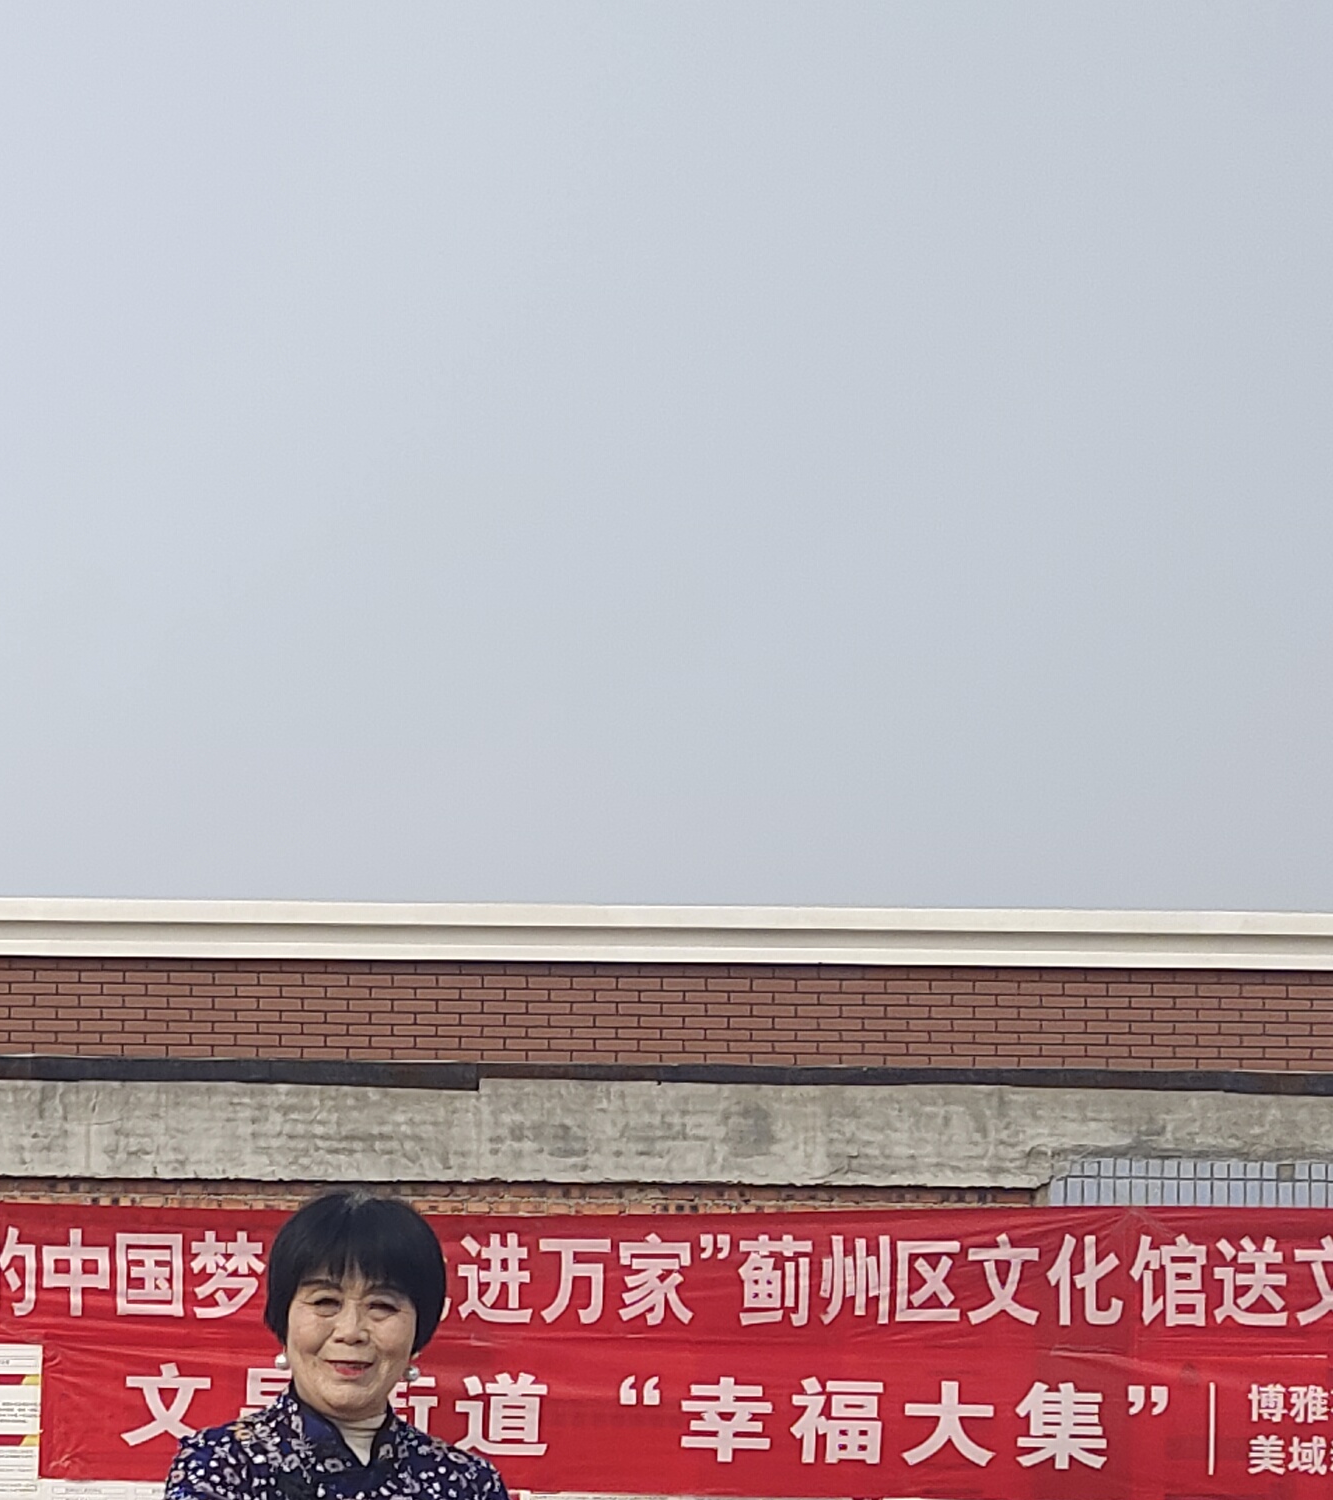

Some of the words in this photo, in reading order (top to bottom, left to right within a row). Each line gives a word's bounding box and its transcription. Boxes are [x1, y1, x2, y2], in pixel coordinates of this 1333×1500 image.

[619, 1375, 1170, 1470] “幸福大集”
[1248, 1383, 1333, 1424] 博雅
[1247, 1434, 1333, 1475] 美域
